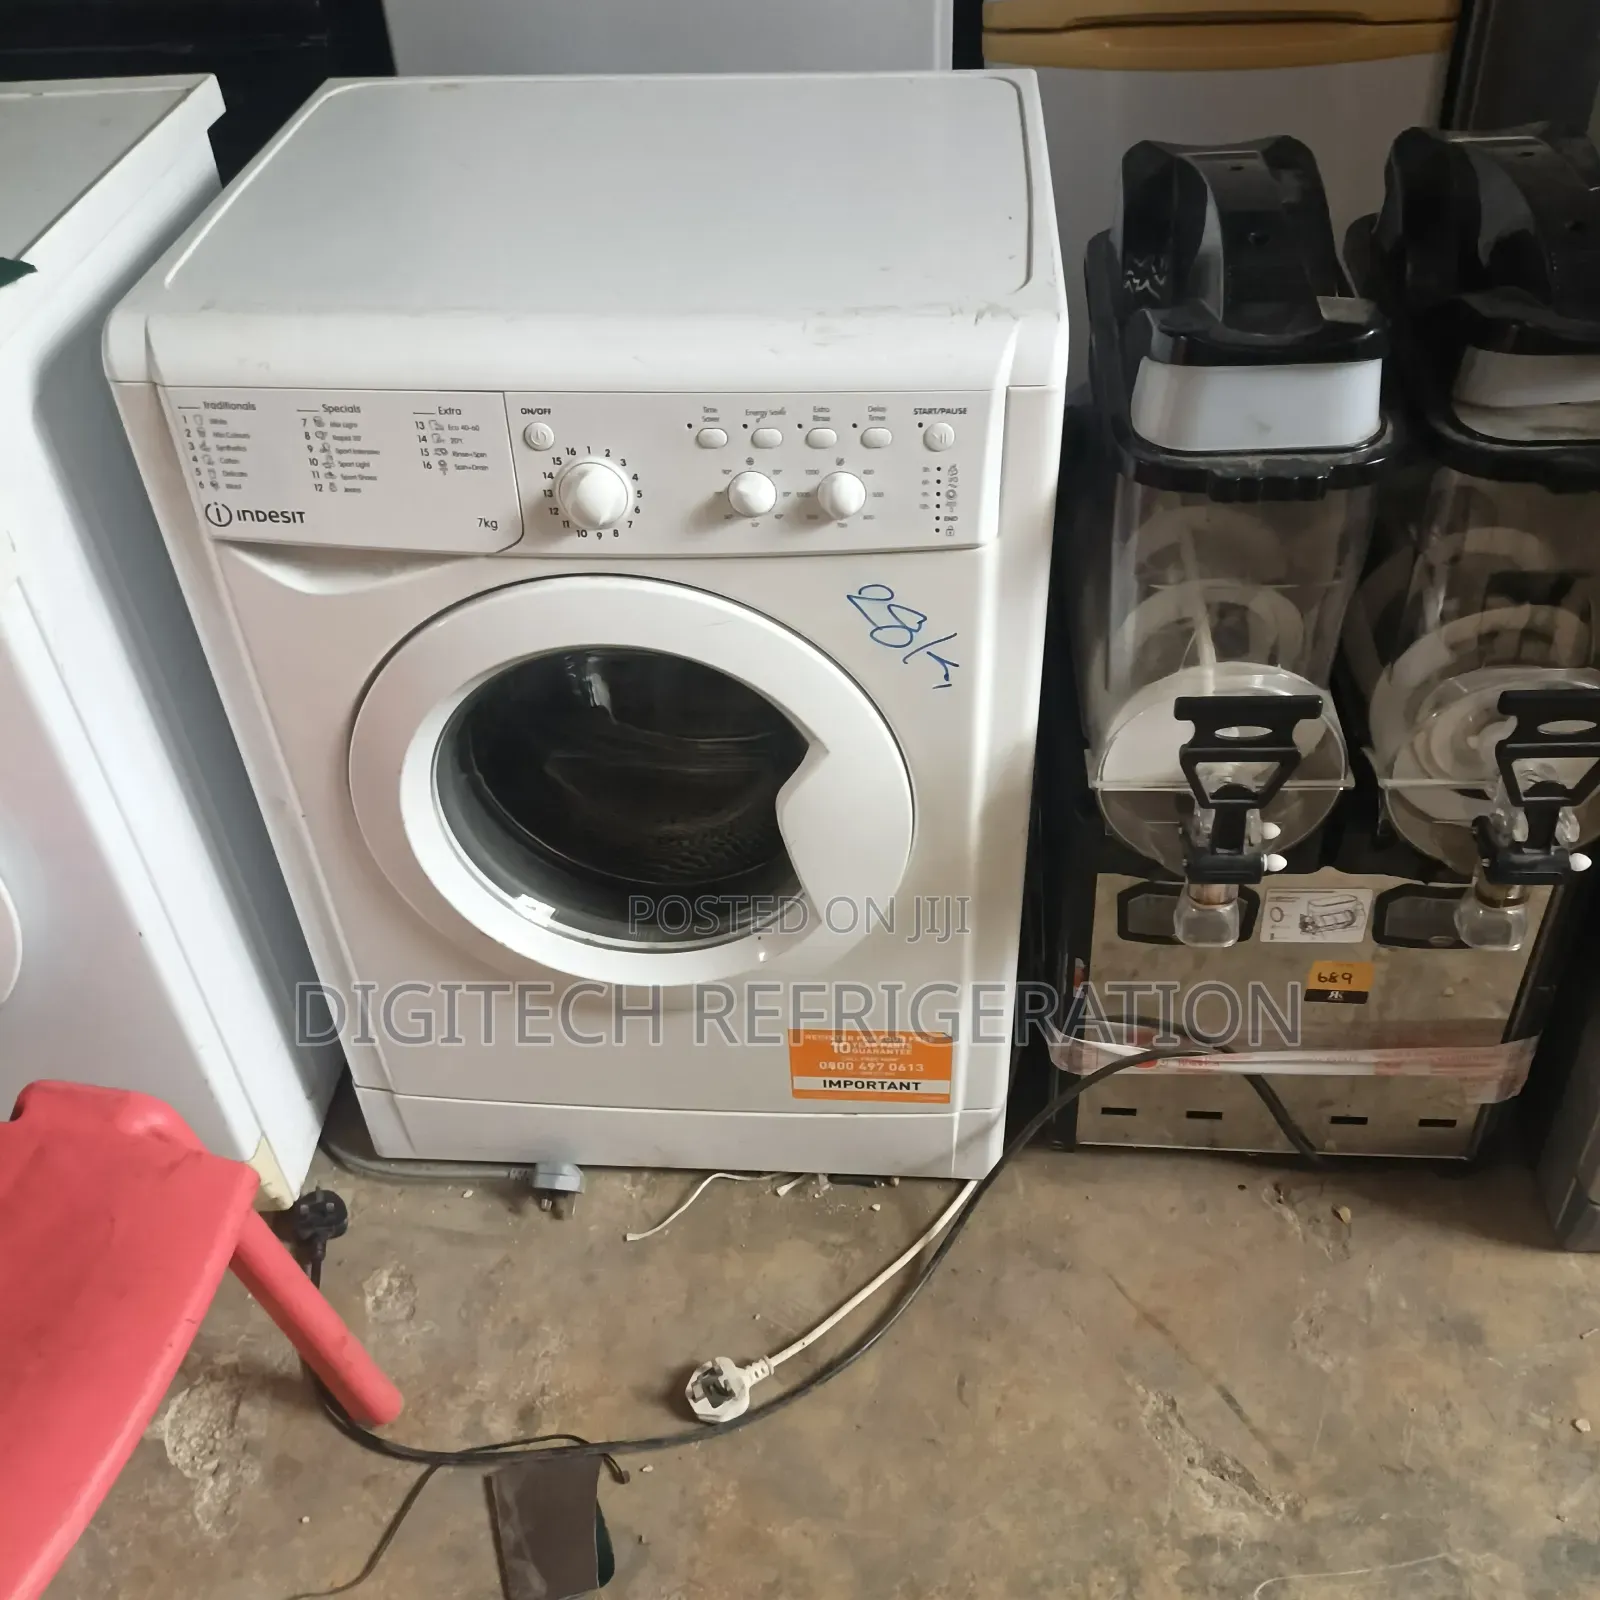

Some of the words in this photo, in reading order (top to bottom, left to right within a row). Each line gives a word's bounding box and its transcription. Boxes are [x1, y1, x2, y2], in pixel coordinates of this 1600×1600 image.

[322, 403, 361, 415] Specials
[438, 406, 462, 415] Extra
[520, 407, 551, 415] ON/OFF
[913, 407, 967, 415] START/PAUSE
[301, 418, 307, 427] 7
[415, 421, 425, 430] 13
[184, 428, 191, 438] 2
[304, 431, 311, 441] 8
[417, 434, 428, 443] 14
[188, 441, 195, 451] 3
[307, 444, 314, 453] 9
[586, 446, 592, 455] 1
[420, 448, 430, 457] 15
[566, 447, 577, 456] 16
[605, 449, 611, 458] 2
[308, 457, 319, 467] 10
[423, 460, 433, 470] 16
[552, 457, 562, 466] 15
[620, 459, 627, 467] 3
[195, 467, 202, 476] 5
[311, 470, 320, 479] 11
[543, 472, 554, 480] 14
[632, 473, 639, 482] 4
[199, 481, 205, 490] 6
[314, 483, 324, 492] 12
[543, 489, 554, 498] 13
[636, 490, 643, 499] 5
[549, 507, 559, 516] 12
[634, 505, 641, 514] 6
[476, 517, 499, 531] 7kg
[562, 520, 570, 529] 11
[627, 520, 634, 529] 7
[576, 530, 588, 538] 10
[596, 532, 602, 541] 9
[613, 530, 619, 538] 8
[1317, 971, 1353, 985] 689
[831, 1041, 851, 1054] 10
[858, 1062, 885, 1071] 497
[889, 1063, 924, 1072] 0613
[822, 1079, 922, 1091] IMPORTANT
